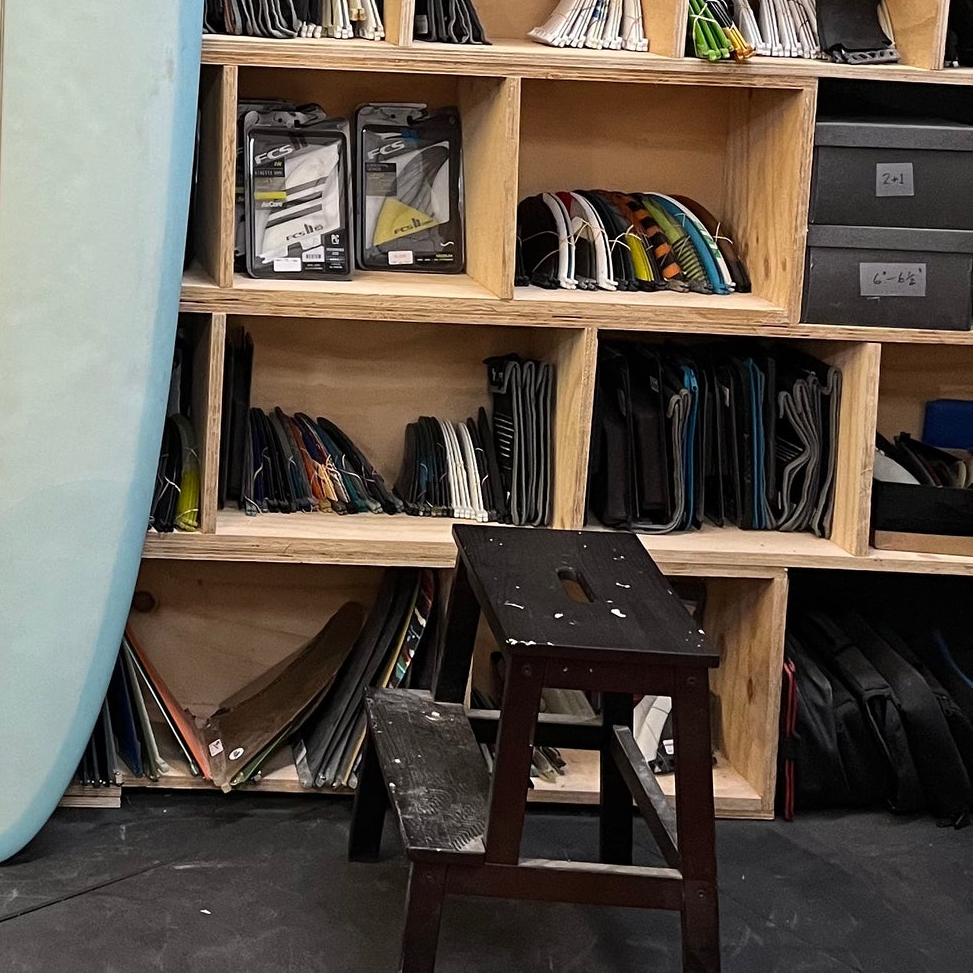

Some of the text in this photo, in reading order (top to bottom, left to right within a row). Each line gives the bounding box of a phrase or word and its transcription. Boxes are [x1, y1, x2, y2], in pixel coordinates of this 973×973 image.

[254, 144, 295, 165] FCS
[367, 140, 406, 160] FCS
[882, 172, 904, 185] 2+1
